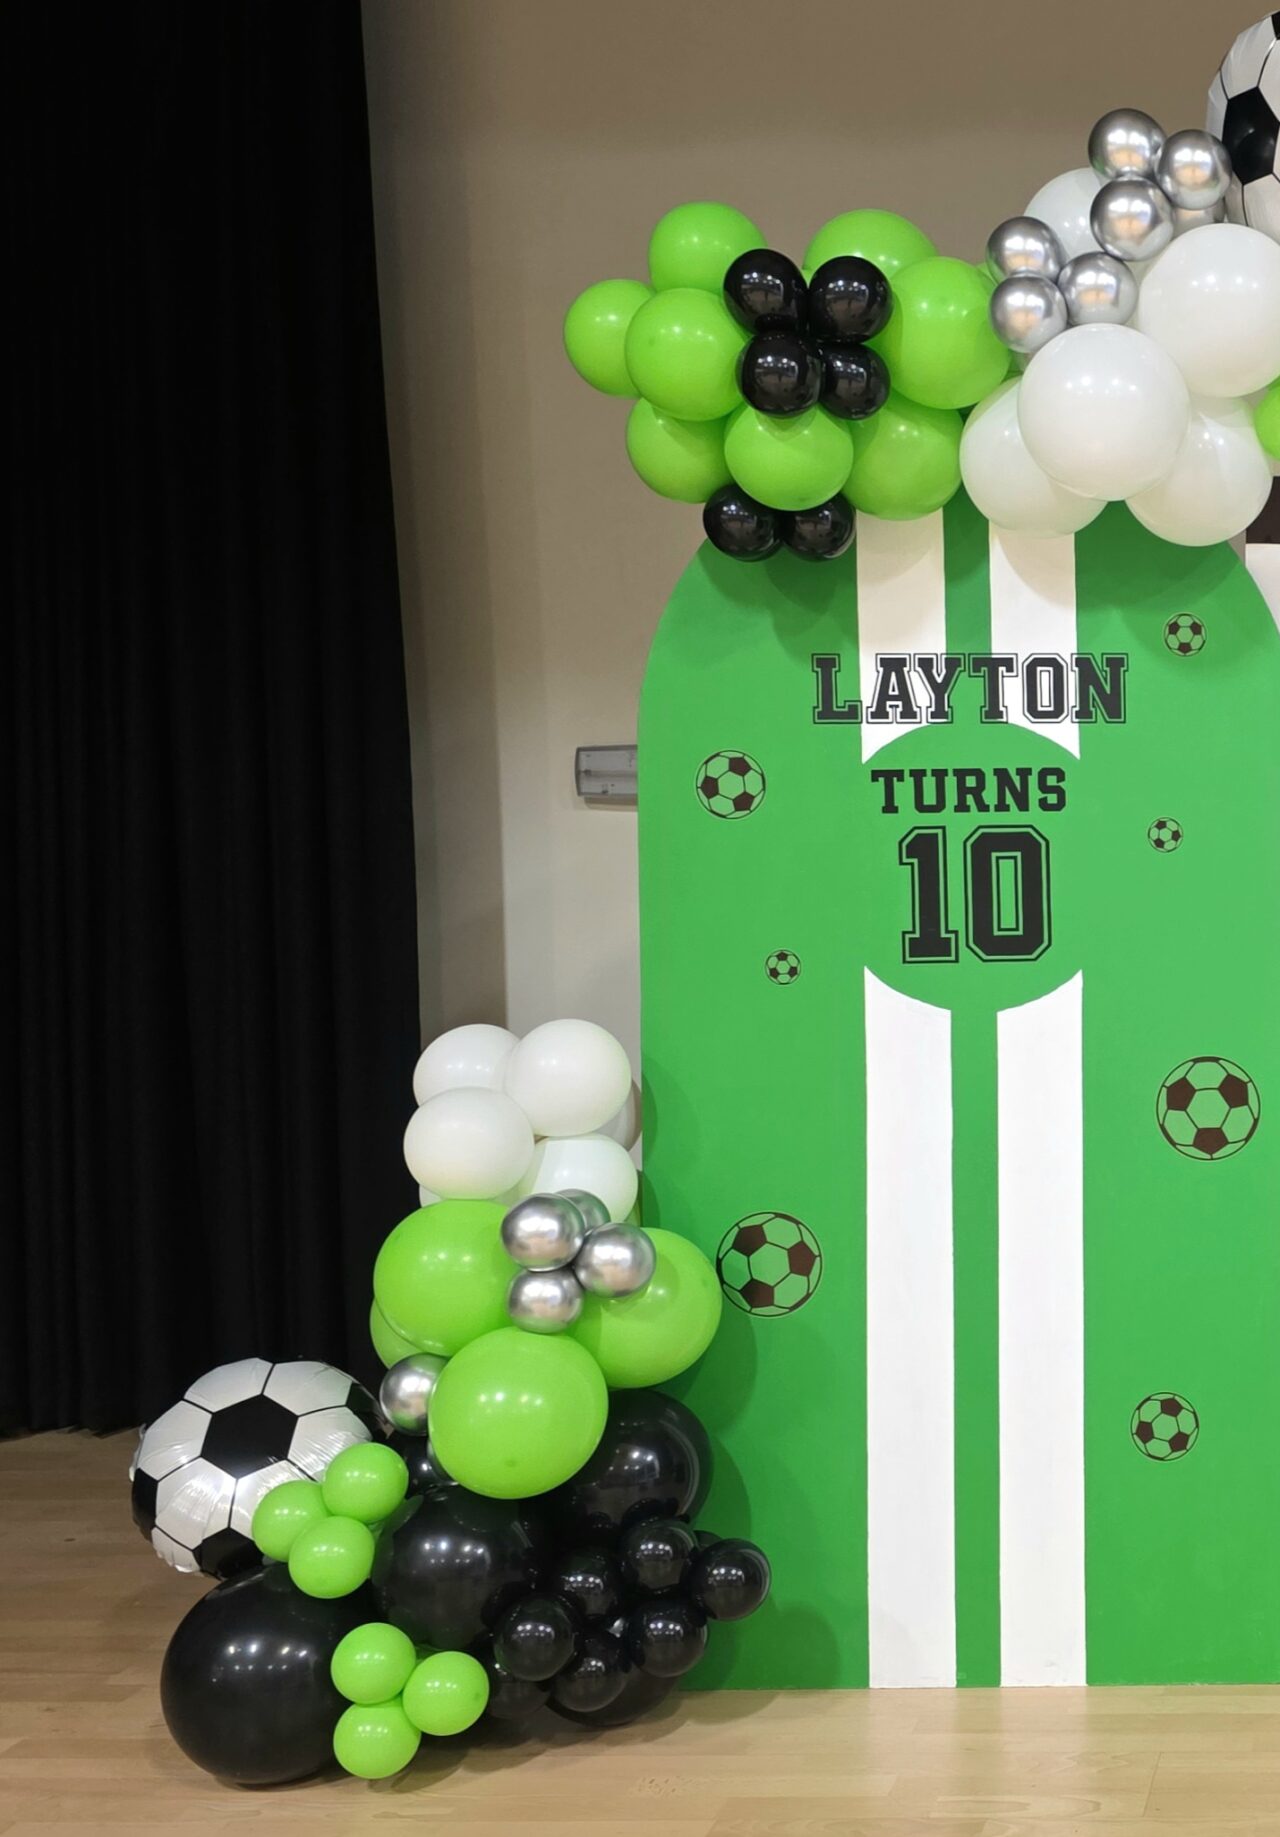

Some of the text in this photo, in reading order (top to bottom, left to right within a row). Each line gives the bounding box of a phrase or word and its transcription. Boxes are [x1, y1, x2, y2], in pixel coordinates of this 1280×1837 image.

[811, 653, 1129, 724] LAYTON
[871, 767, 1067, 814] TURNS
[898, 825, 1052, 964] 10
